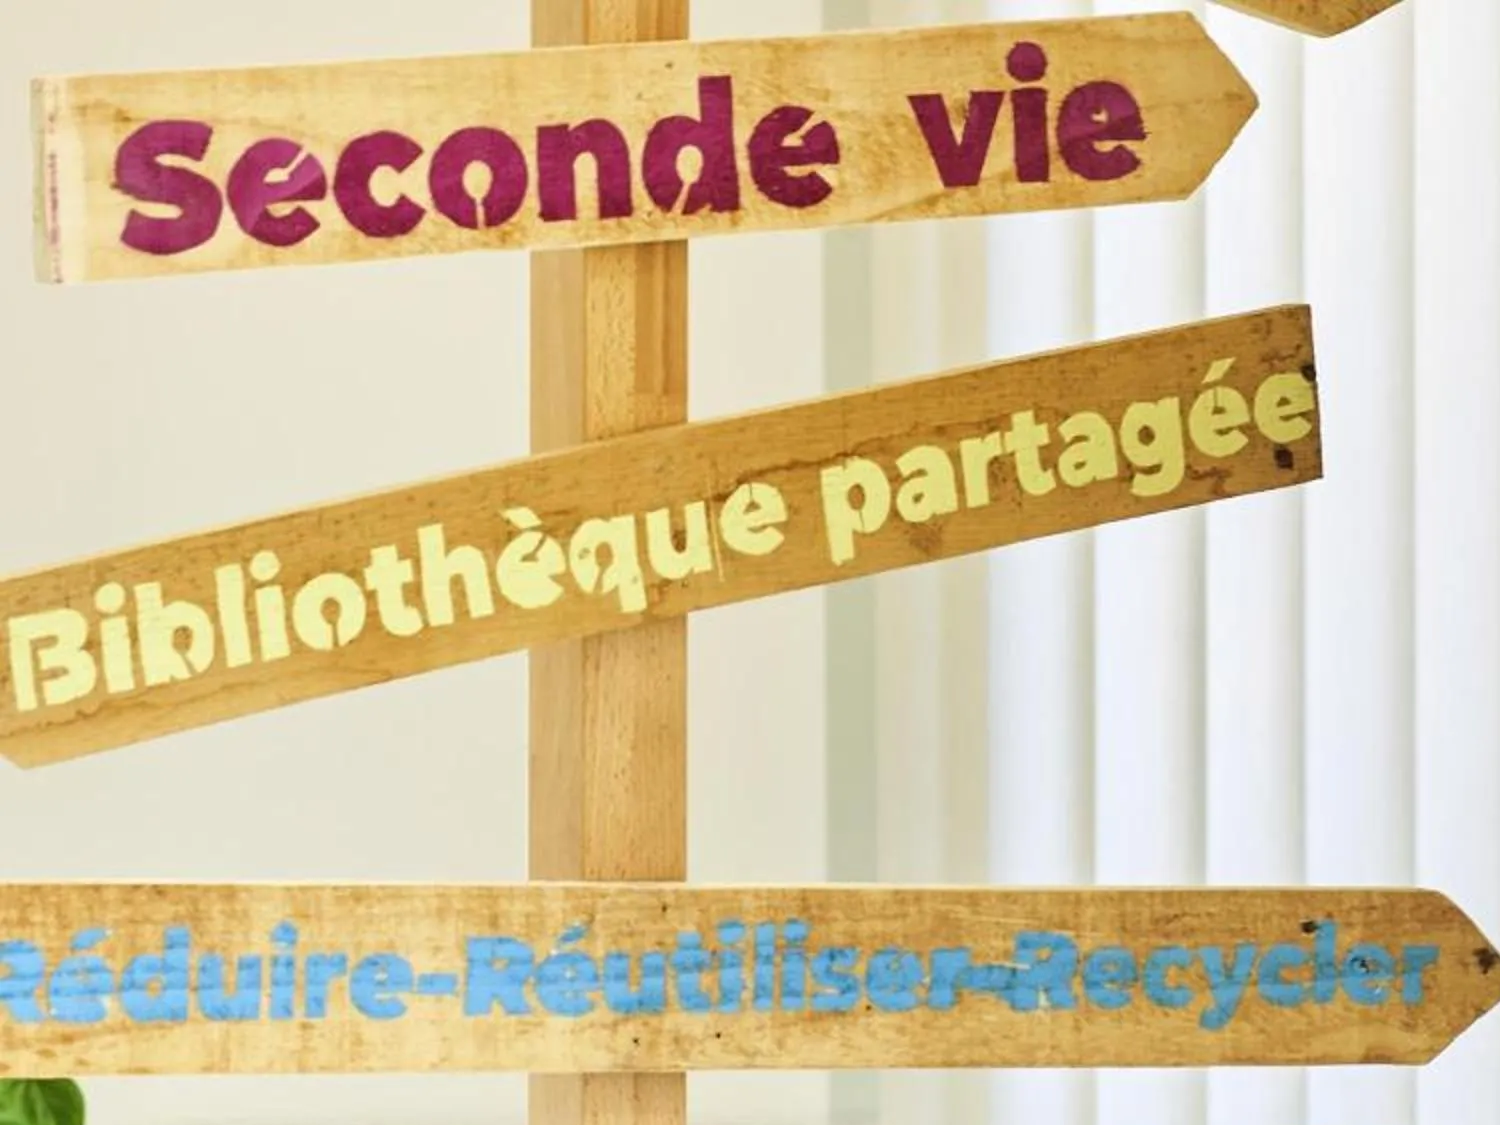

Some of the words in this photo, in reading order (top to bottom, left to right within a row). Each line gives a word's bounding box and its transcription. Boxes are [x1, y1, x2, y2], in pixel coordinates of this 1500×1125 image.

[112, 76, 841, 256] Seconde
[908, 41, 1145, 187] vie
[7, 483, 788, 711] Bibliothèque
[820, 361, 1315, 564] partagée
